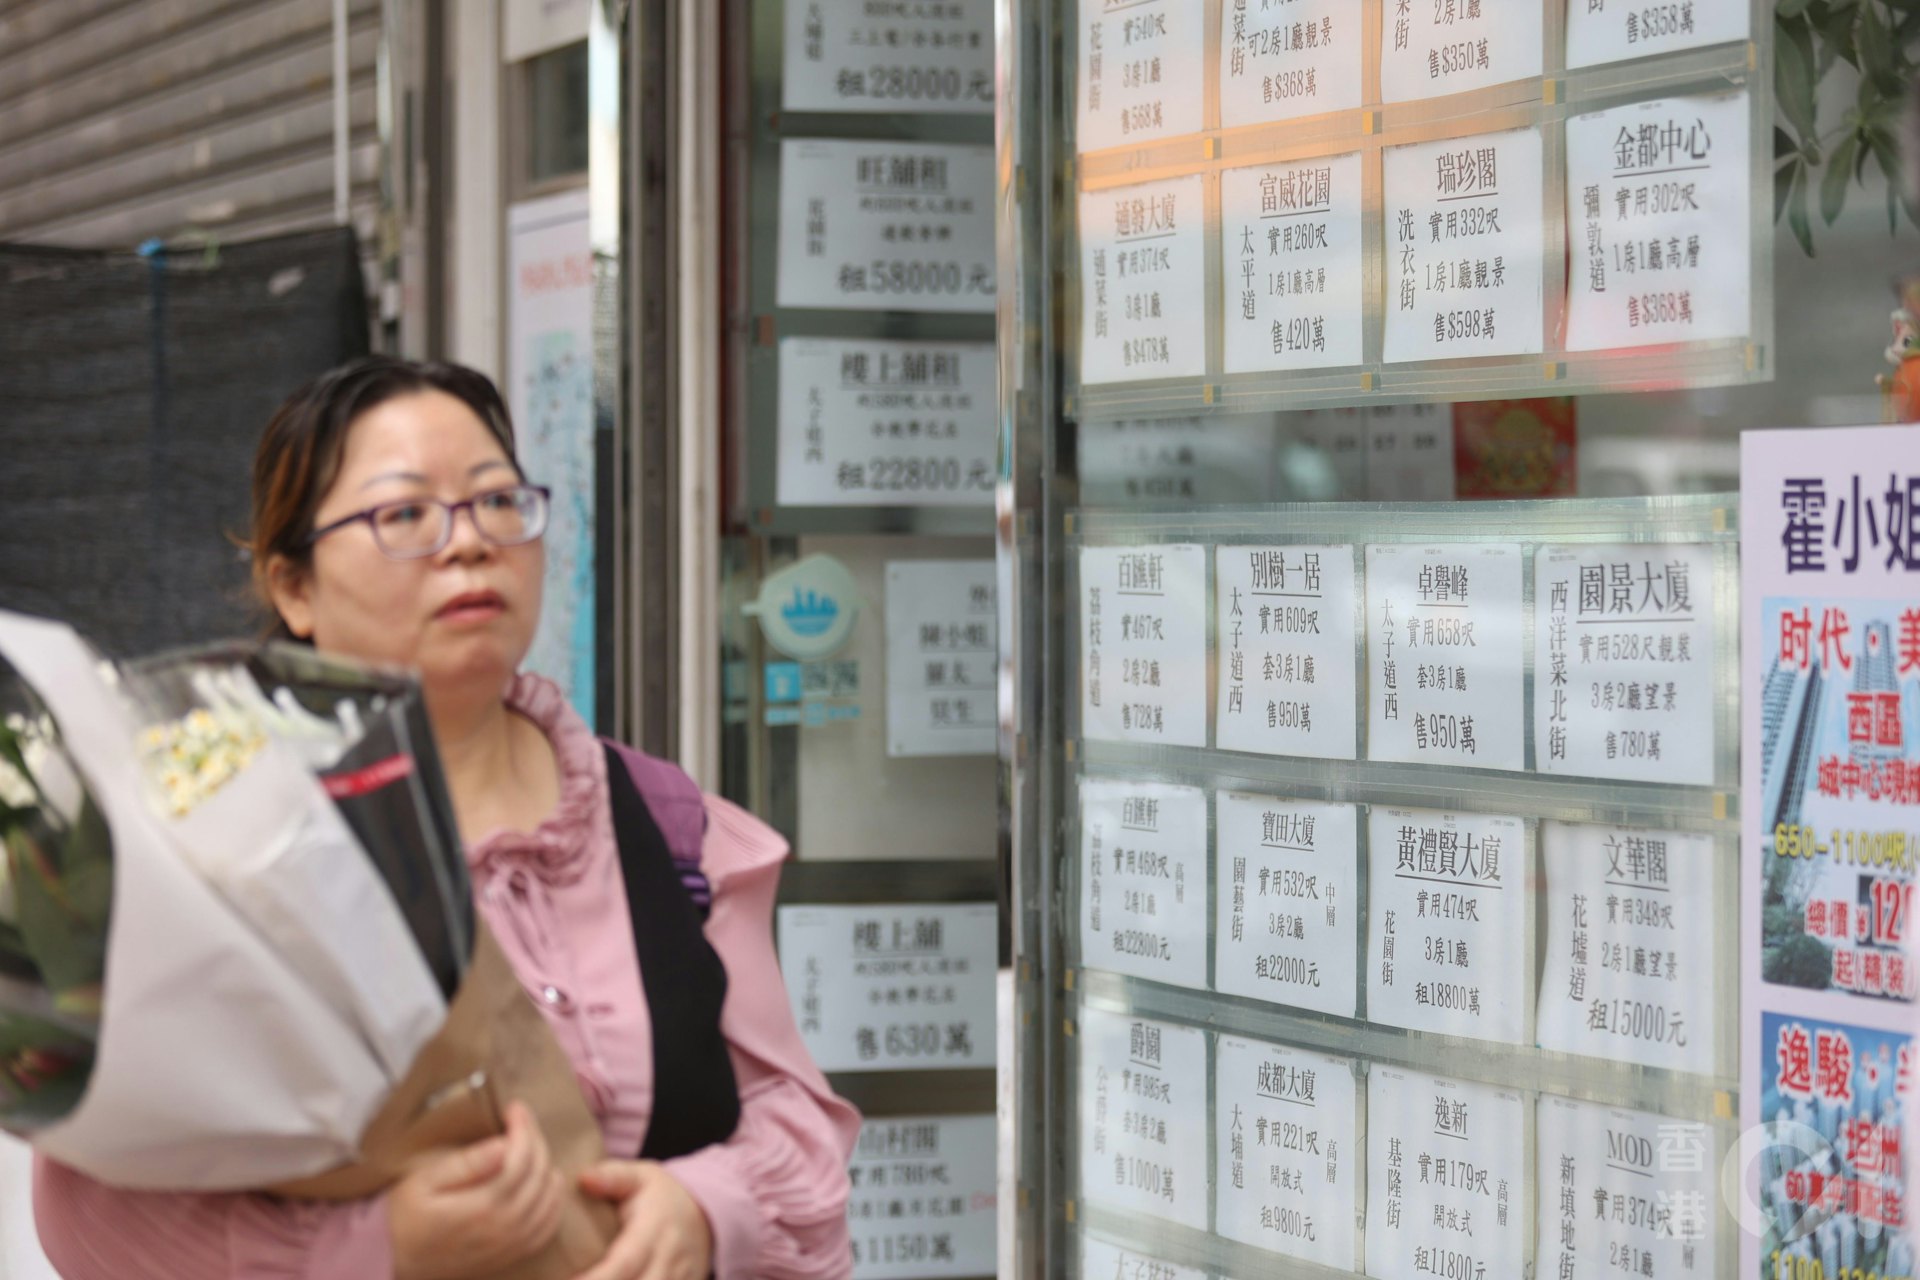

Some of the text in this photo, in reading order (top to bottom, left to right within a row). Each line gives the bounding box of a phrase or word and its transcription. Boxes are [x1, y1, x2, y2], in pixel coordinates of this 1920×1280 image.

[1248, 16, 1332, 58] 可2房1廳靚景
[1626, 2, 1694, 44] 售$358萬
[1428, 38, 1489, 79] 售$350萬
[1263, 67, 1317, 103] 售$368萬
[1614, 118, 1711, 171] 金都中心
[1259, 167, 1331, 213] 富威花園
[1436, 147, 1497, 195] 瑞珍閣
[1614, 182, 1699, 222] 實用302呎
[1267, 223, 1328, 256] 實用260呎
[1429, 207, 1502, 243] 實用332呎
[1584, 185, 1606, 293] 彌敦道
[1240, 225, 1255, 320] 太平道
[1398, 209, 1415, 311] 洗衣街
[1425, 256, 1505, 293] 1房1廳靚景
[1614, 235, 1700, 275] 1房1廳高層
[1269, 267, 1325, 297] 1房1廳高層
[1434, 308, 1495, 343] 售$598萬
[1627, 290, 1693, 328] 售$368萬
[1271, 315, 1325, 354] 售420萬
[1782, 473, 1920, 574] 霍小姐
[1250, 551, 1321, 591] 別樹一居
[1417, 564, 1469, 601] 卓譽峰
[1578, 560, 1693, 615] 園景大廈
[1258, 604, 1320, 635] 實用609呎
[1406, 616, 1477, 648] 實用658呎
[1228, 586, 1244, 715] 太子道西
[1262, 652, 1315, 684] 套3房1廳
[1381, 598, 1398, 721] 太子道西
[1549, 579, 1569, 761] 西洋菜北街
[1416, 663, 1467, 692] 套3房1廳
[1591, 681, 1677, 711] 3房2廳望景
[1266, 699, 1311, 733] 售950萬
[1414, 711, 1476, 755] 售950萬
[1604, 730, 1661, 761] 售780萬
[1261, 811, 1315, 846] 寶田大廈
[1396, 825, 1502, 882] 黃禮賢大廈
[1602, 834, 1669, 884] 文華閣
[1258, 866, 1319, 900] 實用532呎
[1325, 882, 1336, 927] 中層
[1416, 889, 1480, 922] 實用474呎
[1606, 894, 1675, 930] 實用348呎
[1269, 912, 1304, 940] 3房2廳
[1382, 910, 1395, 987] 花園街
[1425, 936, 1469, 968] 3房1廳
[1568, 893, 1588, 1002] 花墟道
[1601, 942, 1678, 982] 2房1廳望景
[1255, 955, 1320, 988] 租22000元
[1415, 982, 1480, 1016] 租18800萬
[1587, 998, 1687, 1047] 租15000元
[1257, 1061, 1316, 1102] 成都大廈
[1434, 1096, 1468, 1134] 逸新
[1231, 1104, 1243, 1189] 大埔道
[1256, 1116, 1320, 1155] 實用221呎
[1607, 1129, 1653, 1168] MOD
[1270, 1165, 1304, 1195] 開放式
[1326, 1139, 1337, 1184] 高層
[1418, 1152, 1489, 1196] 實用179呎
[1387, 1138, 1401, 1229] 基隆街
[1498, 1178, 1507, 1227] 高層
[1260, 1205, 1315, 1242] 租9800元
[1433, 1205, 1472, 1237] 開放式
[1560, 1153, 1576, 1280] 新填地街
[1414, 1246, 1486, 1280] 租11800元
[1610, 1241, 1653, 1278] 2房1廳
